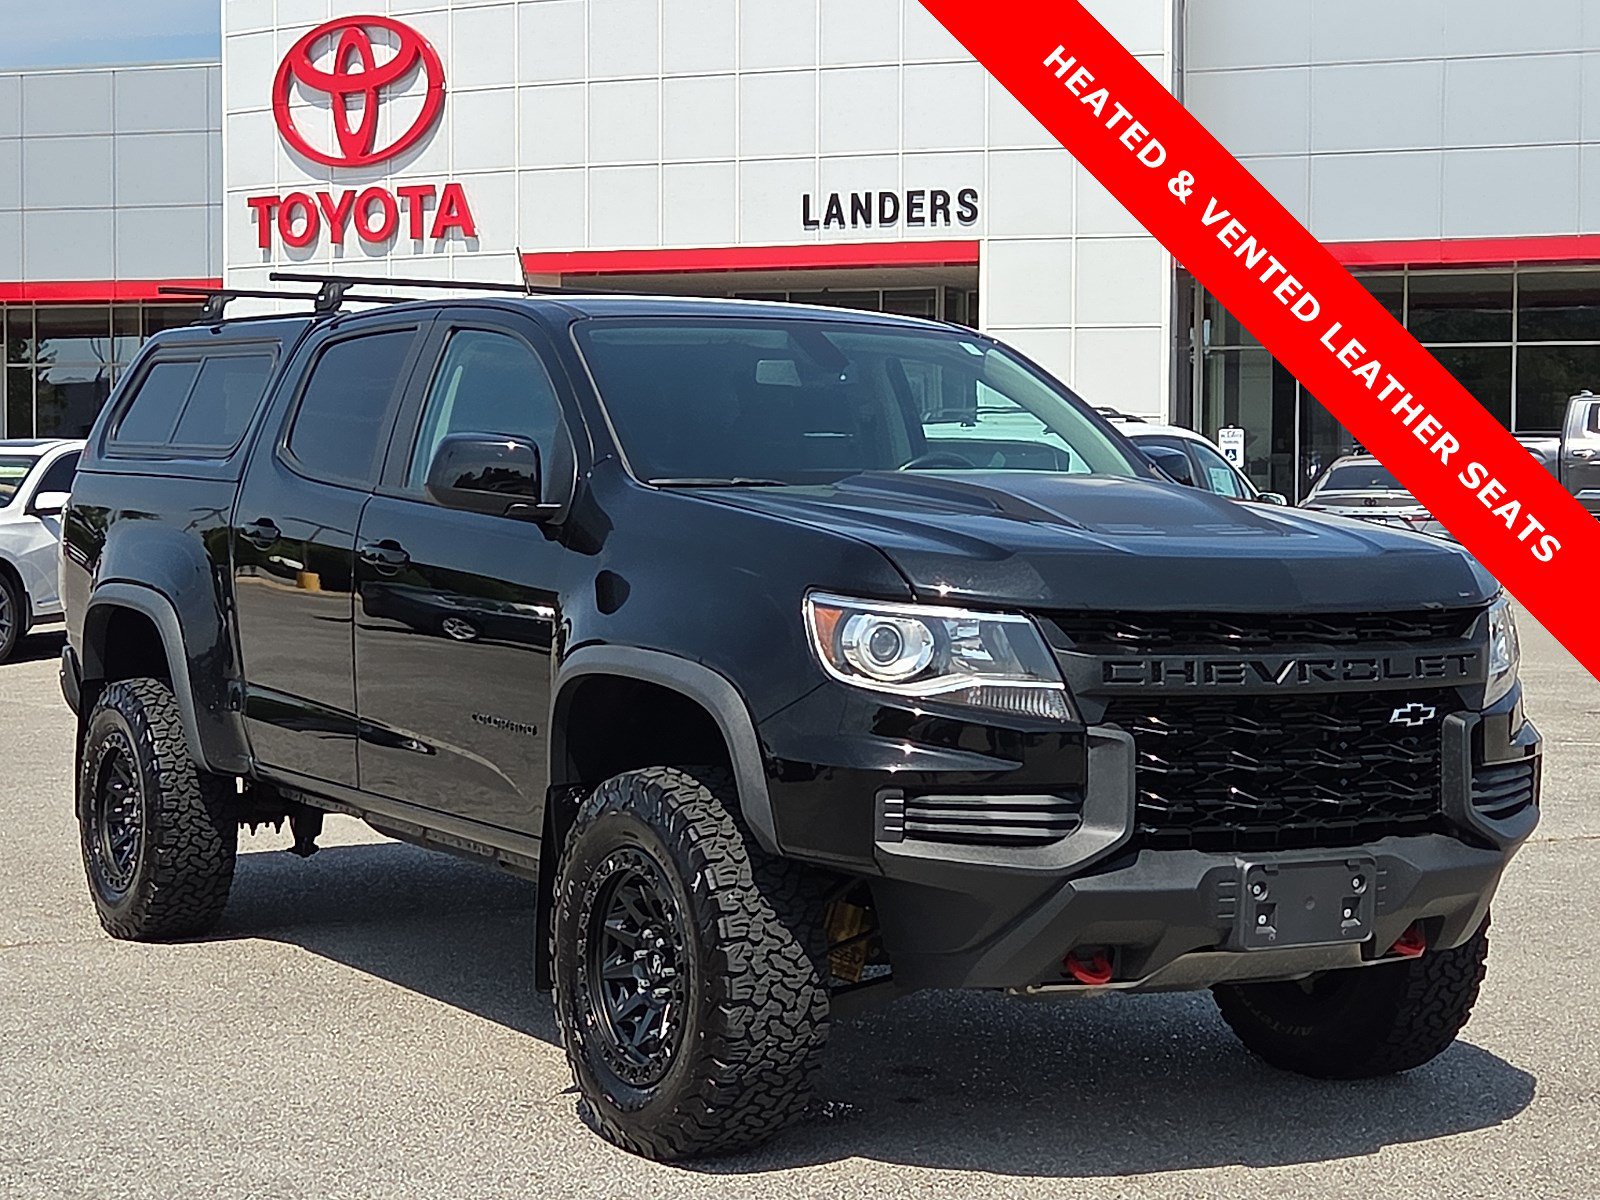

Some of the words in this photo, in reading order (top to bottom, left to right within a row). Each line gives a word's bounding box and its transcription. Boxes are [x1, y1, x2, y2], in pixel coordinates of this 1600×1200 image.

[247, 183, 477, 248] TOYOTA
[802, 187, 979, 227] LANDERS
[1102, 653, 1477, 686] CHEVROLET
